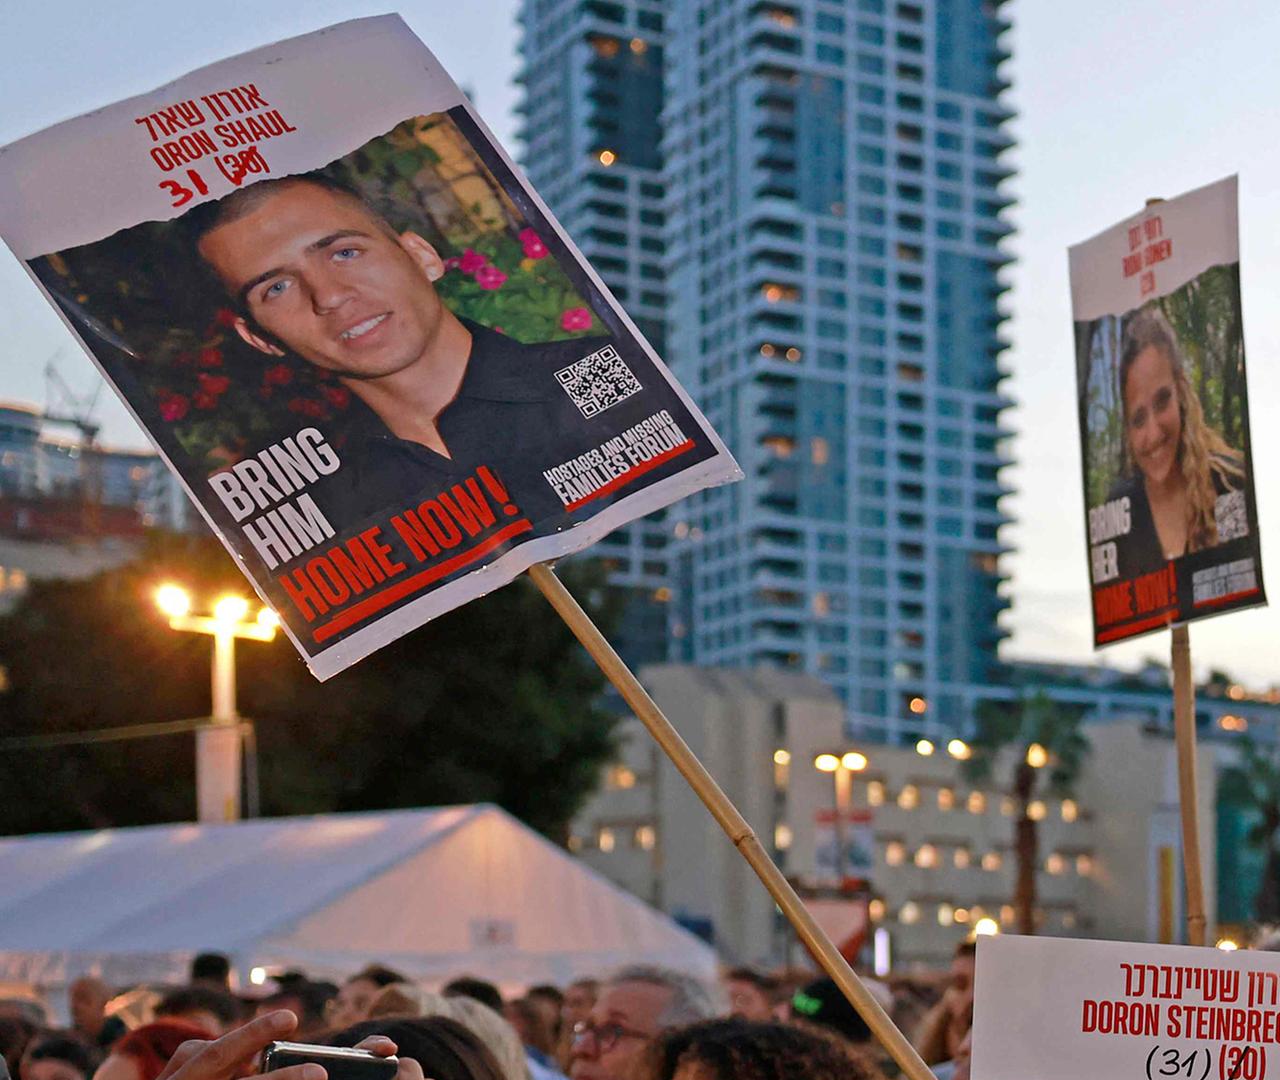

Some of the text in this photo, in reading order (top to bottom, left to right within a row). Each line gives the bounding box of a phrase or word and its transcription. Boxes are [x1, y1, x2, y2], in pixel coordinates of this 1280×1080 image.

[135, 84, 269, 141] אורון שאול
[150, 110, 297, 171] ORON SHAUL
[159, 169, 208, 208] 31
[208, 427, 341, 522] BRING
[543, 409, 674, 486] HOSTAGES AND MISSING
[553, 423, 689, 505] FAMILIES FORUM
[242, 492, 336, 570] HIM
[279, 465, 519, 622] HOME NOW!
[1091, 541, 1119, 584] HER
[1120, 963, 1240, 1003] שטיינברכר
[1082, 1000, 1160, 1036] DORON
